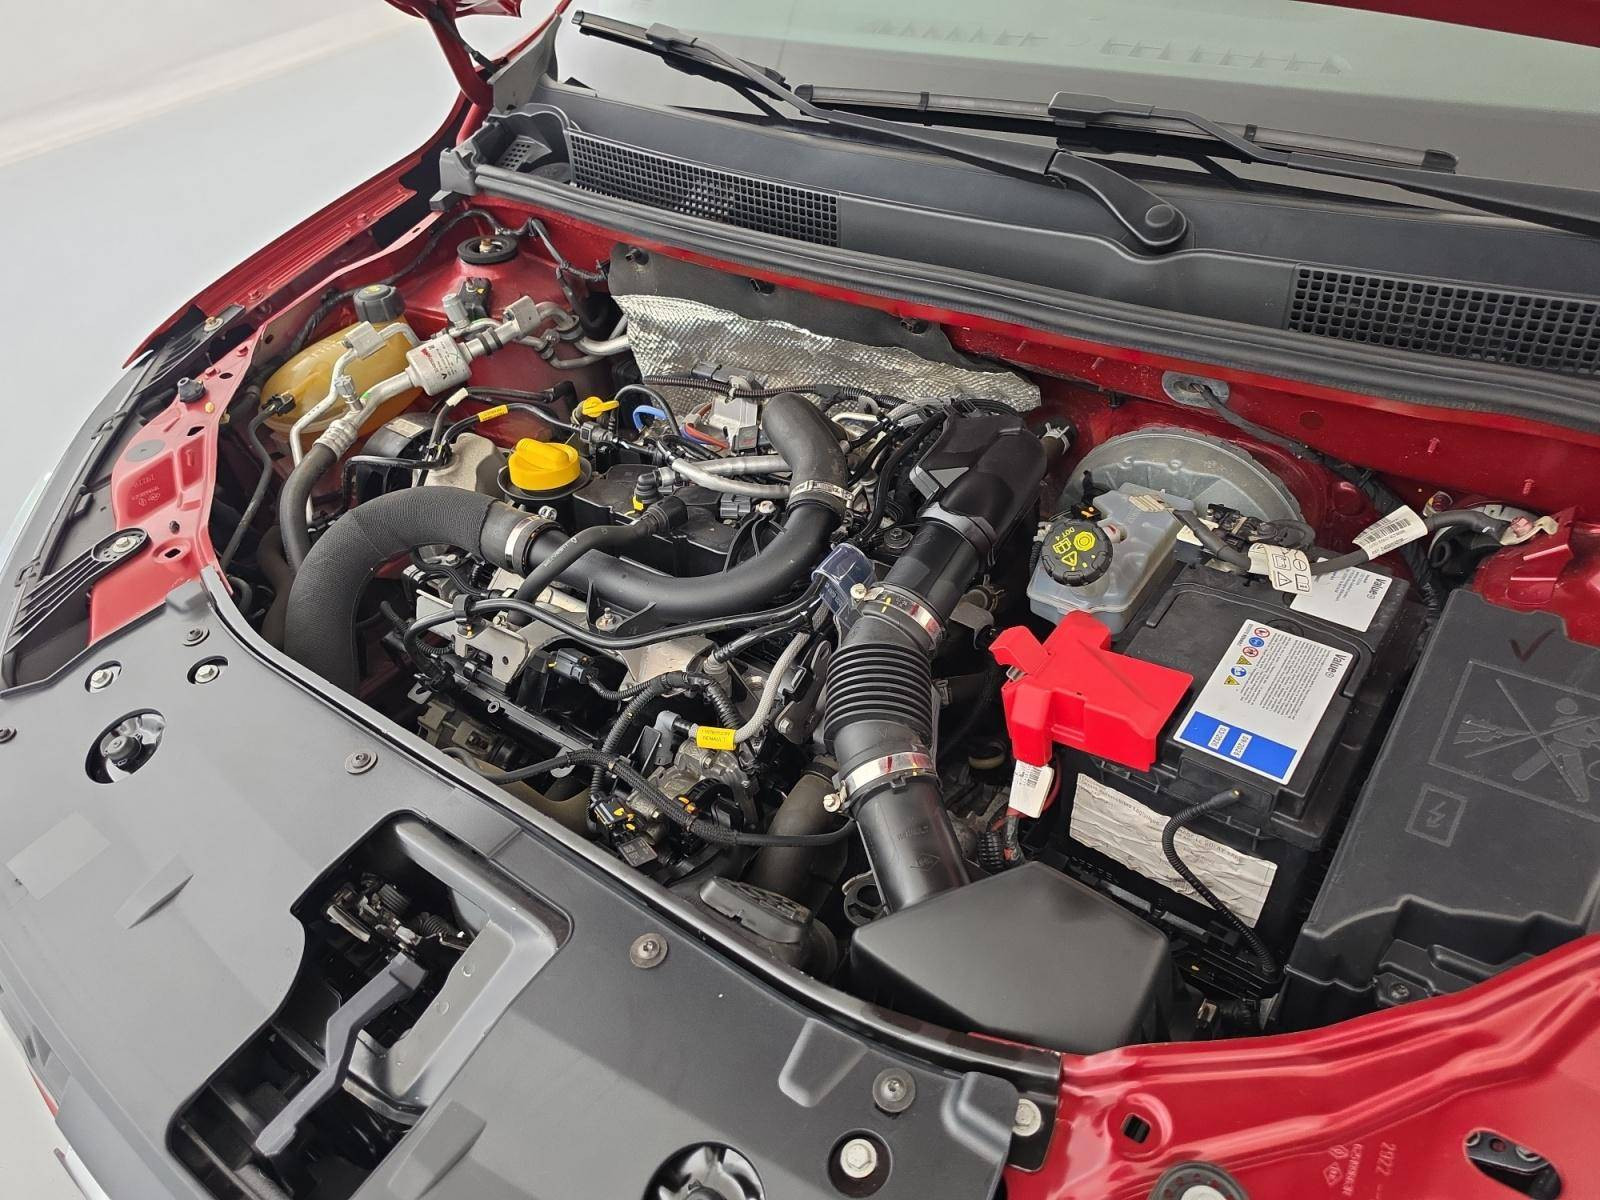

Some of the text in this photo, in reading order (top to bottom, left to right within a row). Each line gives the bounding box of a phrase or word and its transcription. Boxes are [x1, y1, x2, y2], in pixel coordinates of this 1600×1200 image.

[1062, 526, 1075, 538] DOT
[1370, 578, 1387, 595] Value
[1330, 653, 1347, 674] Value
